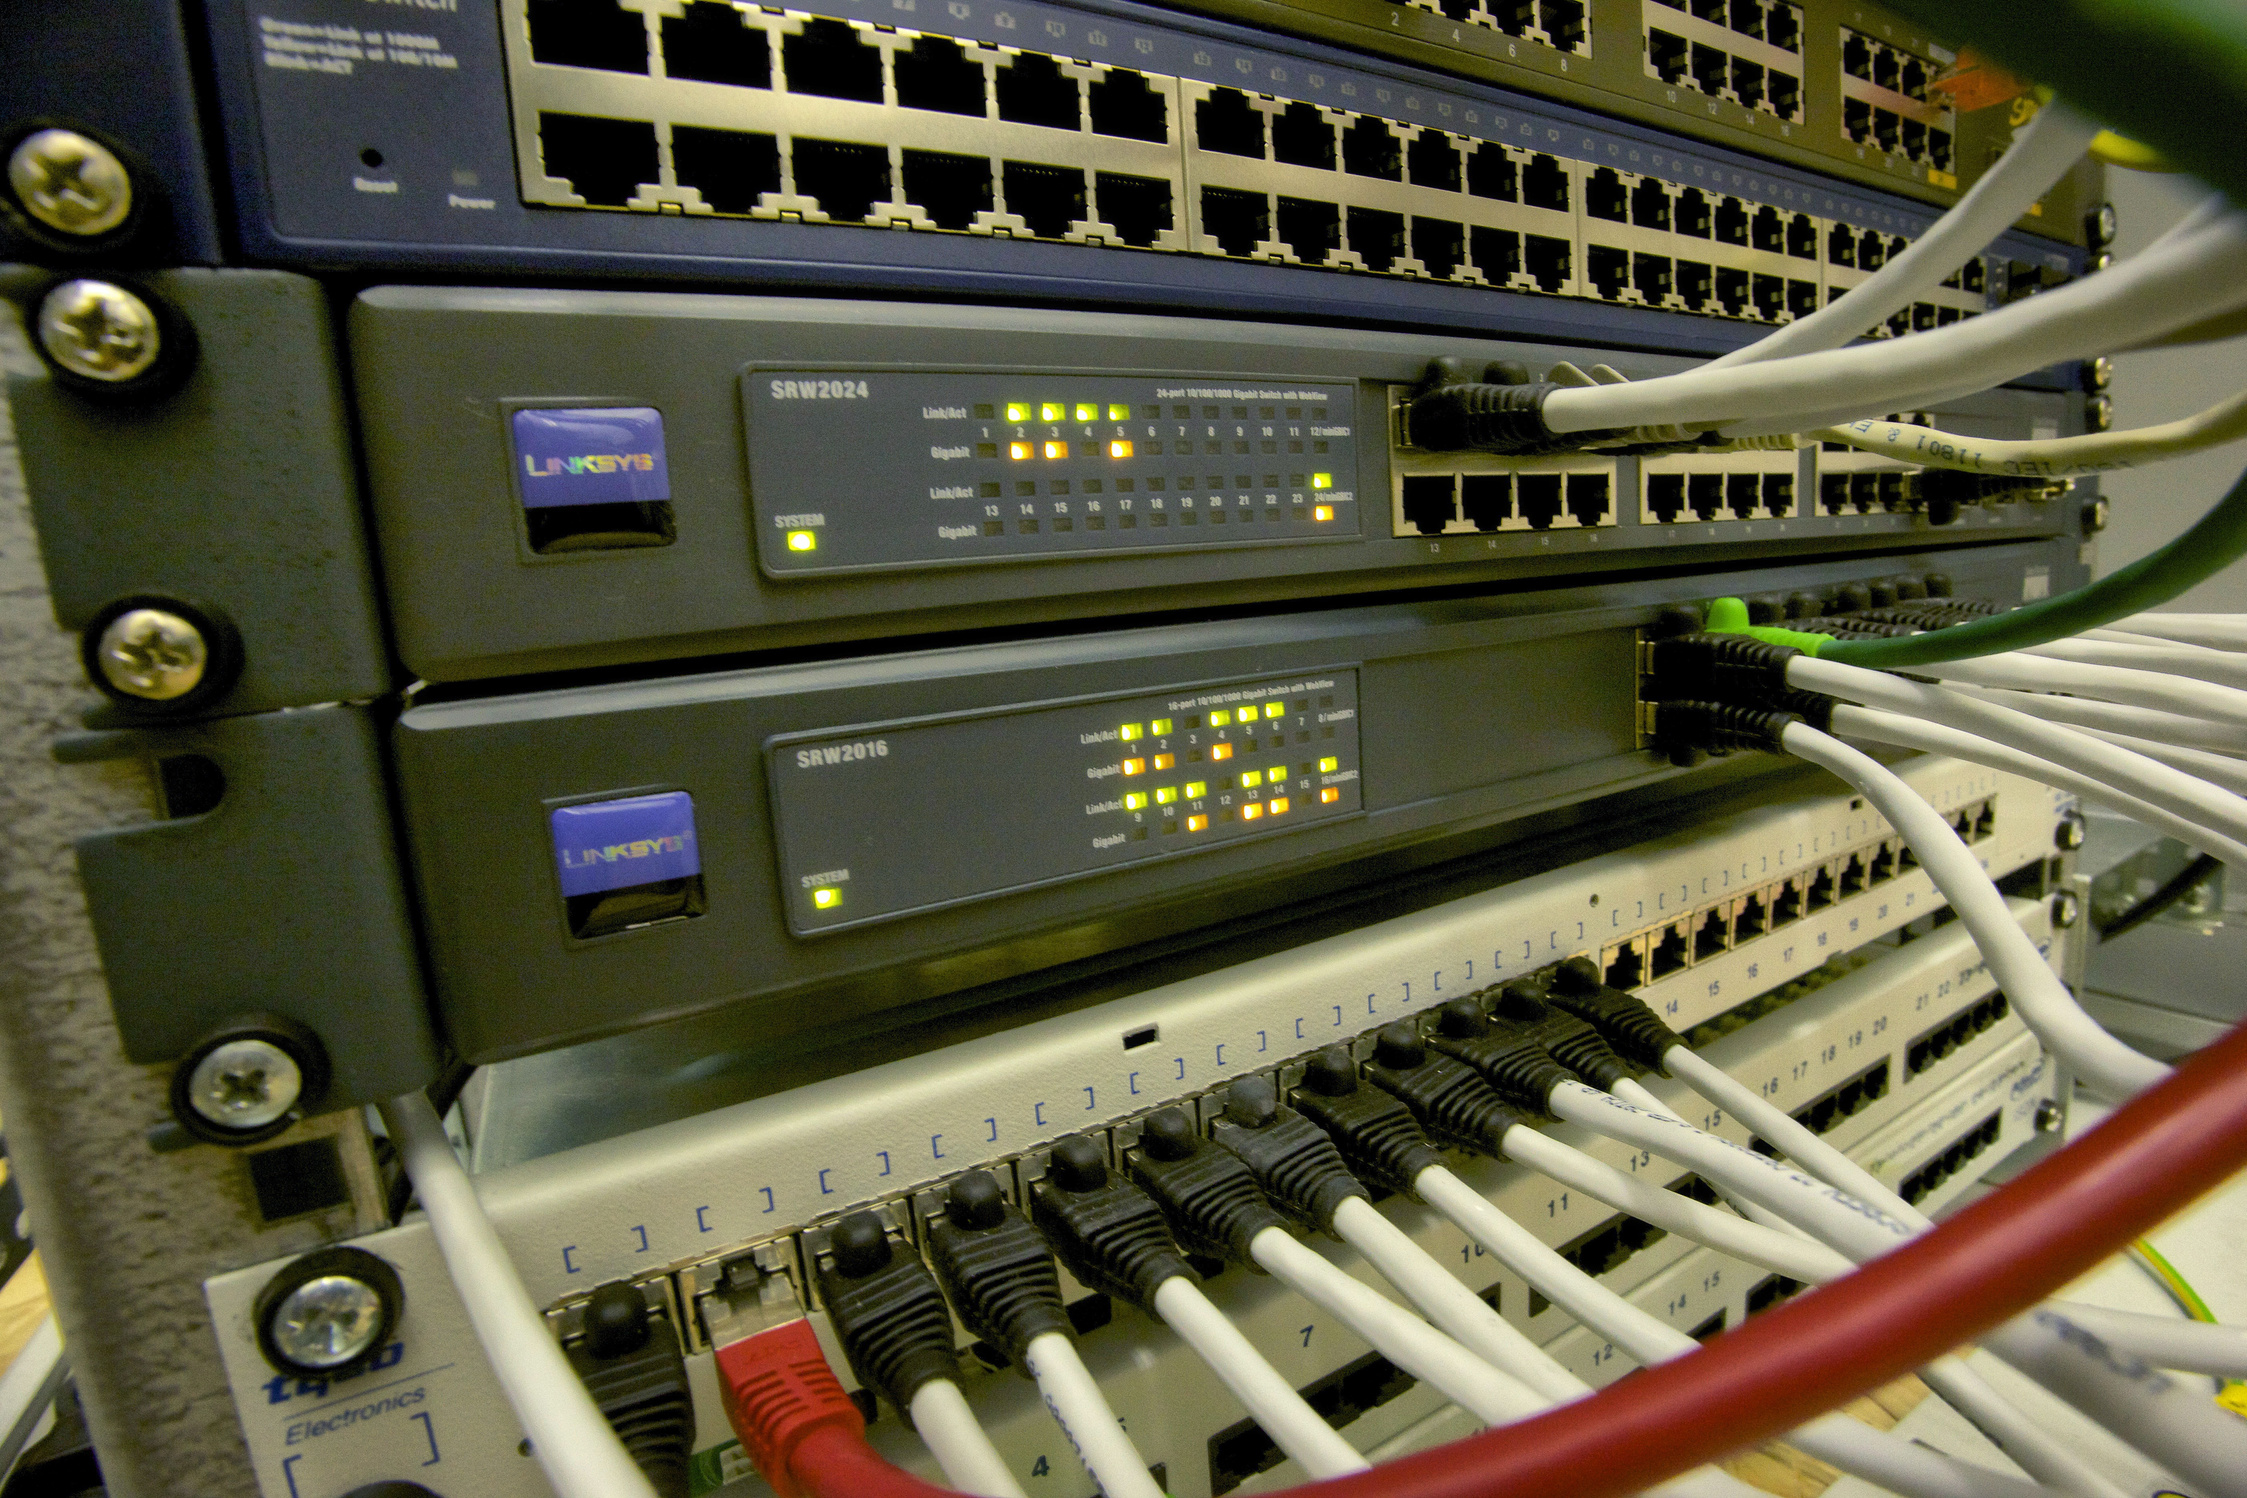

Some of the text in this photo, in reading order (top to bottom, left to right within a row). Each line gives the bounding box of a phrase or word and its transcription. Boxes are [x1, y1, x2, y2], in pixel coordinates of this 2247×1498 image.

[1391, 11, 1399, 27] 2
[1452, 28, 1461, 42] 4
[1508, 43, 1516, 57] 6
[1560, 58, 1567, 72] 8
[1666, 90, 1676, 103] 10
[1707, 102, 1717, 115] 12
[771, 380, 869, 399] SRW2024
[982, 427, 989, 438] 1
[1017, 427, 1025, 438] 2
[1051, 426, 1059, 438] 3
[1084, 426, 1092, 437] 4
[1116, 426, 1125, 437] 5
[1148, 426, 1156, 437] 6
[1178, 426, 1186, 437] 7
[1208, 426, 1215, 437] 8
[1236, 426, 1244, 437] 9
[1262, 426, 1273, 437] 10
[1289, 426, 1299, 437] 11
[524, 453, 655, 477] LINKSYS
[1150, 498, 1163, 509] 18
[1181, 497, 1193, 508] 19
[1209, 496, 1222, 507] 20
[1239, 495, 1250, 506] 21
[1265, 494, 1277, 505] 22
[1292, 493, 1303, 504] 23
[984, 505, 999, 517] 13
[1020, 504, 1034, 515] 14
[1054, 502, 1068, 513] 15
[1087, 501, 1100, 512] 16
[1119, 500, 1132, 511] 17
[774, 513, 825, 528] SYSTEM
[1272, 721, 1279, 731] 6
[1299, 717, 1305, 726] 7
[1218, 729, 1226, 739] 4
[1246, 726, 1252, 735] 5
[1160, 739, 1167, 749] 2
[1190, 734, 1197, 744] 3
[797, 739, 889, 769] SRW2016
[1131, 743, 1137, 754] 1
[1273, 784, 1284, 794] 14
[1299, 779, 1310, 789] 15
[1220, 794, 1232, 805] 12
[1247, 790, 1259, 800] 13
[1192, 800, 1203, 811] 11
[1162, 806, 1174, 817] 10
[1134, 812, 1142, 823] 9
[563, 836, 684, 869] LINKSYS
[801, 868, 850, 888] SYSTEM
[1783, 947, 1794, 962] 17
[1747, 963, 1759, 979] 16
[1708, 981, 1720, 998] 15
[1666, 999, 1678, 1017] 14
[1873, 1016, 1888, 1035] 20
[1849, 1030, 1862, 1049] 19
[1822, 1045, 1836, 1064] 18
[1793, 1060, 1808, 1080] 17
[1763, 1076, 1779, 1098] 16
[1704, 1108, 1722, 1130] 15
[1630, 1150, 1650, 1172] 13
[1548, 1192, 1568, 1218] 11
[1703, 1271, 1721, 1292] 15
[1300, 1324, 1315, 1348] 7
[1593, 1343, 1613, 1366] 12
[286, 1387, 426, 1446] Electronics
[1032, 1454, 1050, 1477] 4
